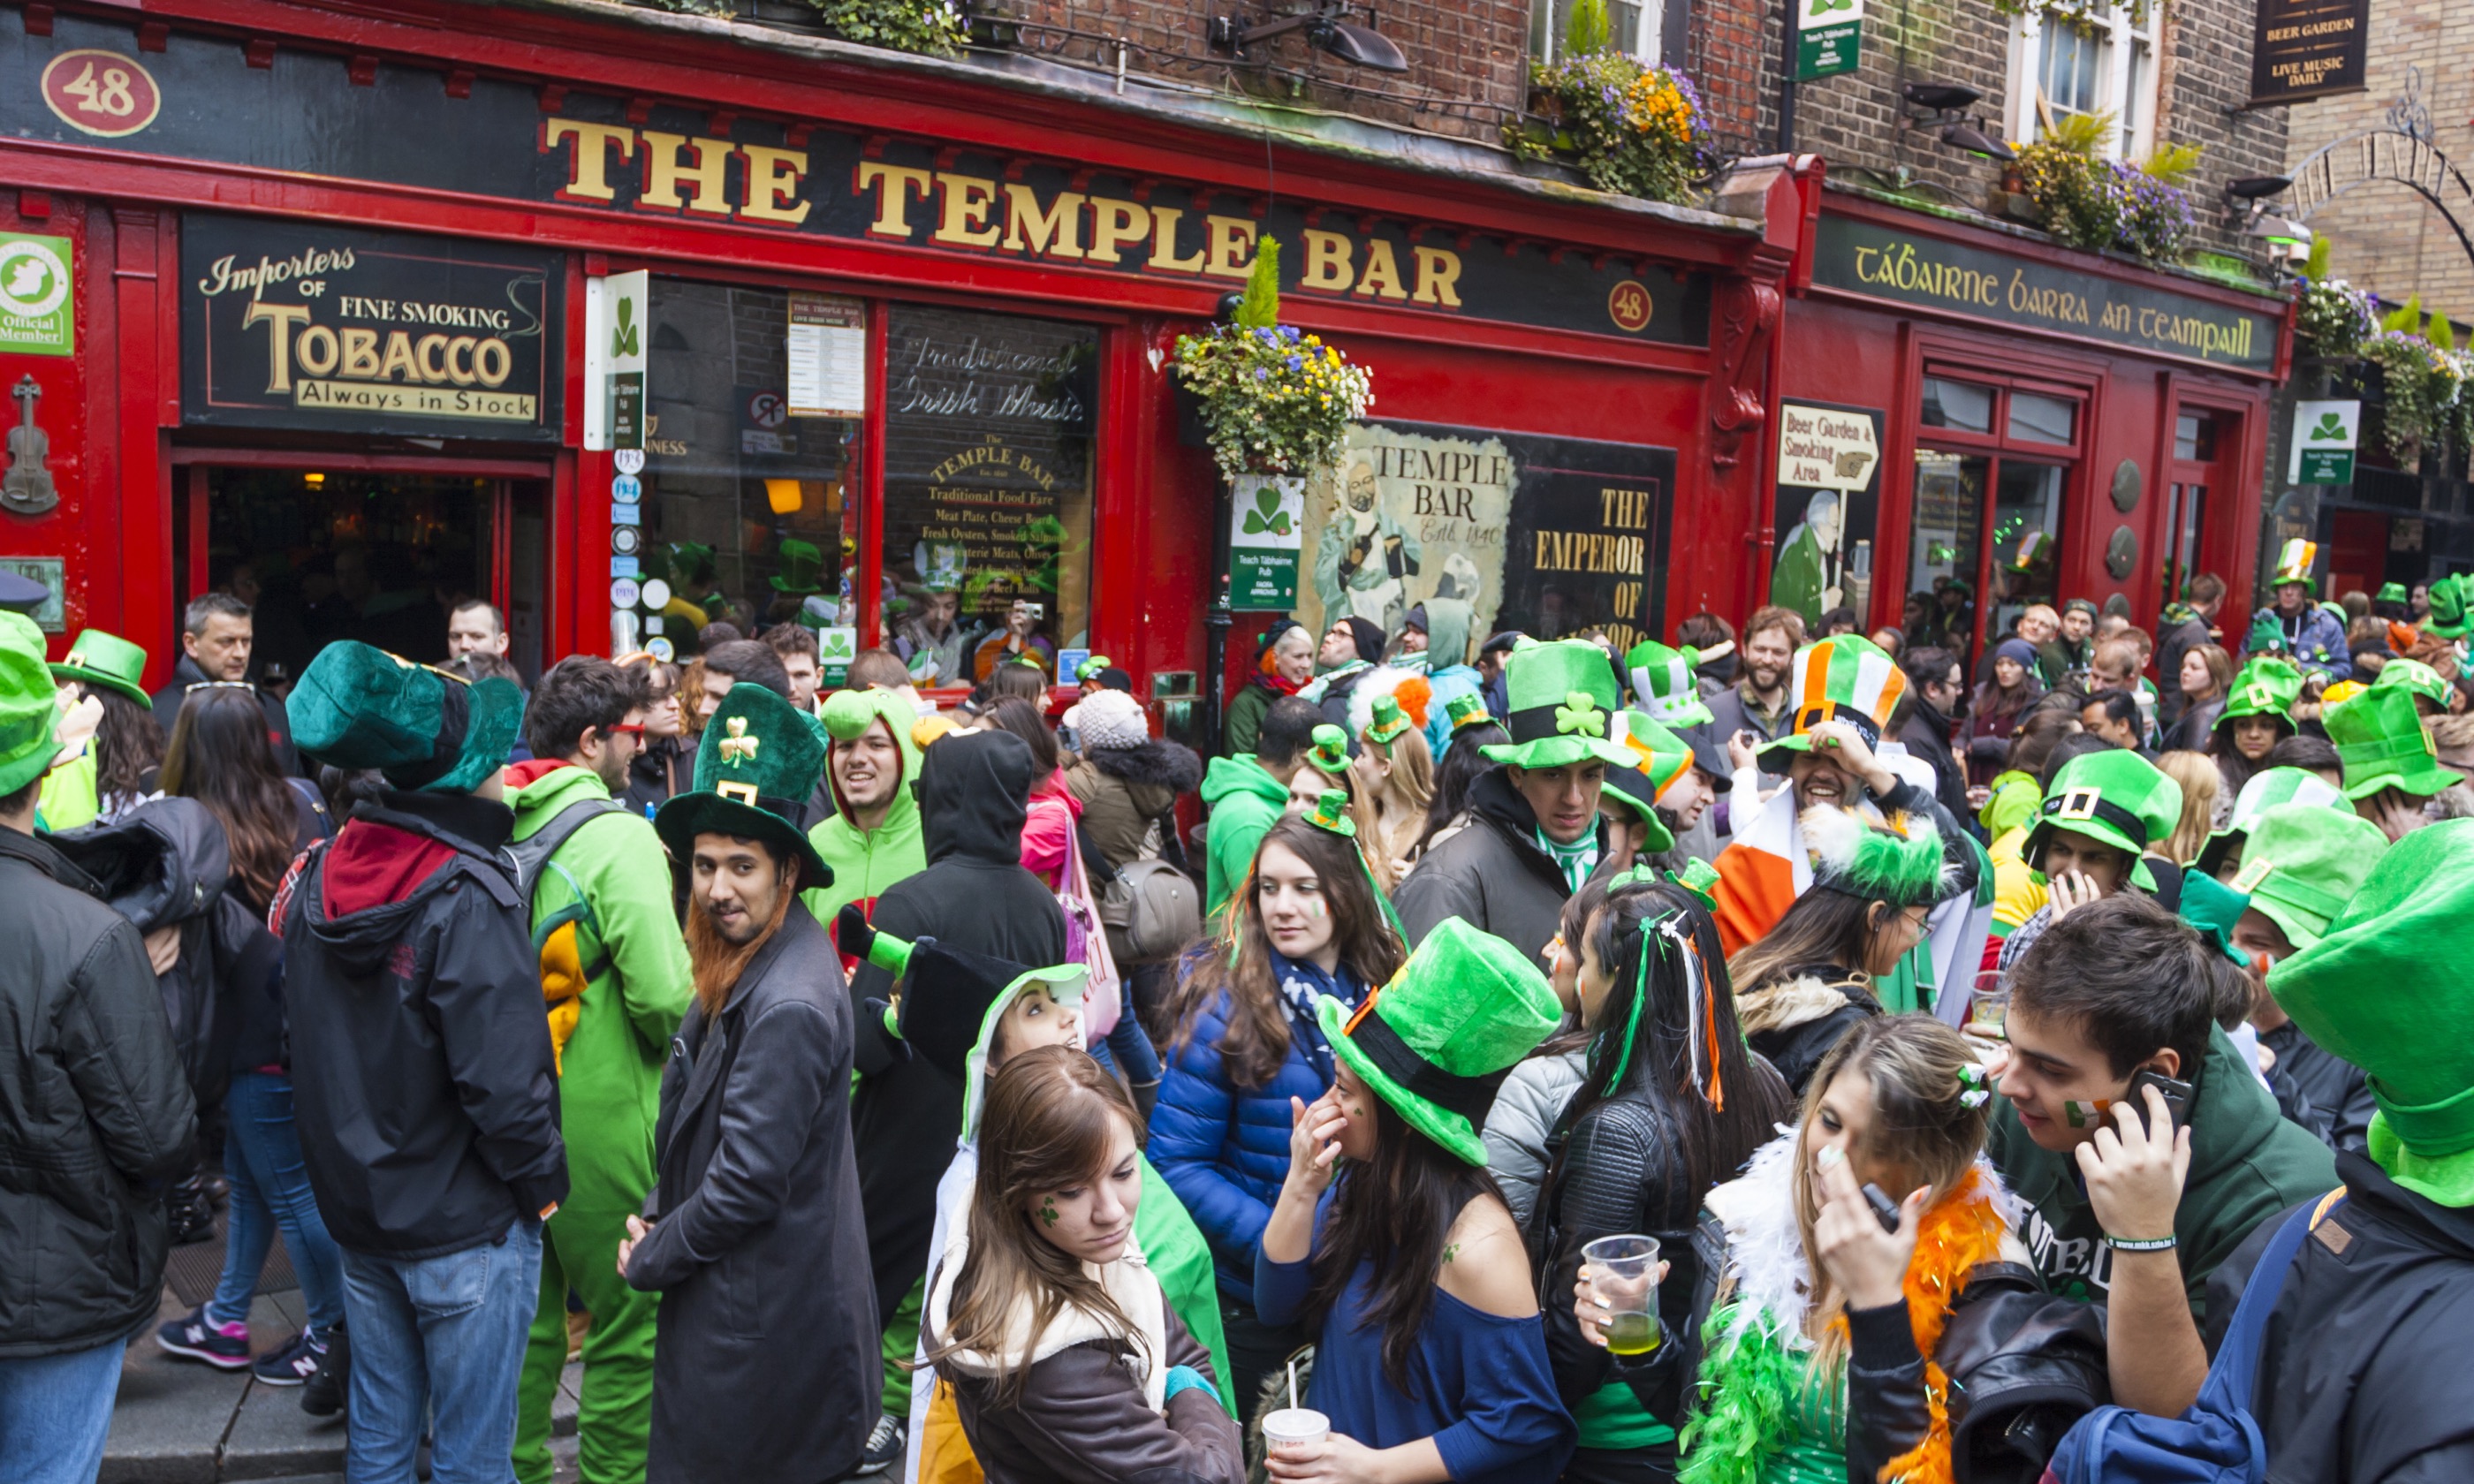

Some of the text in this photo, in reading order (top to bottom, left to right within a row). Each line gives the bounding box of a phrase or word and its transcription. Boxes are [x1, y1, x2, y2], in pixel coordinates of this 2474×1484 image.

[2266, 18, 2356, 42] BEER GARDEN
[2272, 56, 2344, 78] LIVE MUSIC
[2288, 71, 2326, 87] DAILY
[63, 61, 135, 117] 48
[543, 117, 1463, 307] THE TEMPLE BAR
[199, 246, 356, 301] Importers
[299, 280, 327, 299] OF
[339, 296, 511, 330] FINE SMOKING
[812, 305, 842, 314] TEMPLE
[1614, 287, 1642, 321] 48
[0, 328, 59, 342] Member
[3, 315, 54, 330] Official
[899, 337, 1077, 373] Traditional
[301, 382, 531, 415] Always in Stock
[998, 384, 1084, 421] Music
[983, 434, 1003, 444] The
[1786, 412, 1814, 435] Beer
[1818, 416, 1860, 441] Garden
[1784, 436, 1834, 464] Smoking
[930, 446, 1055, 492] TEMPLE BAR
[1372, 444, 1507, 488] TEMPLE
[1792, 462, 1821, 482] Area
[929, 487, 1054, 506] Traditional Food Fare
[1414, 483, 1476, 523] BAR
[1601, 488, 1649, 530] THE
[936, 508, 1053, 525] Meat Plate, Cheese Board
[922, 526, 948, 539] Fresh
[951, 526, 988, 541] Oysters,
[990, 528, 1027, 541] Smoked
[991, 546, 1021, 560] Meats,
[1239, 555, 1259, 565] Teach
[1535, 530, 1644, 575] EMPEROR
[1258, 566, 1272, 577] Pub
[1017, 582, 1040, 594] Rolls
[1613, 580, 1643, 619] OF
